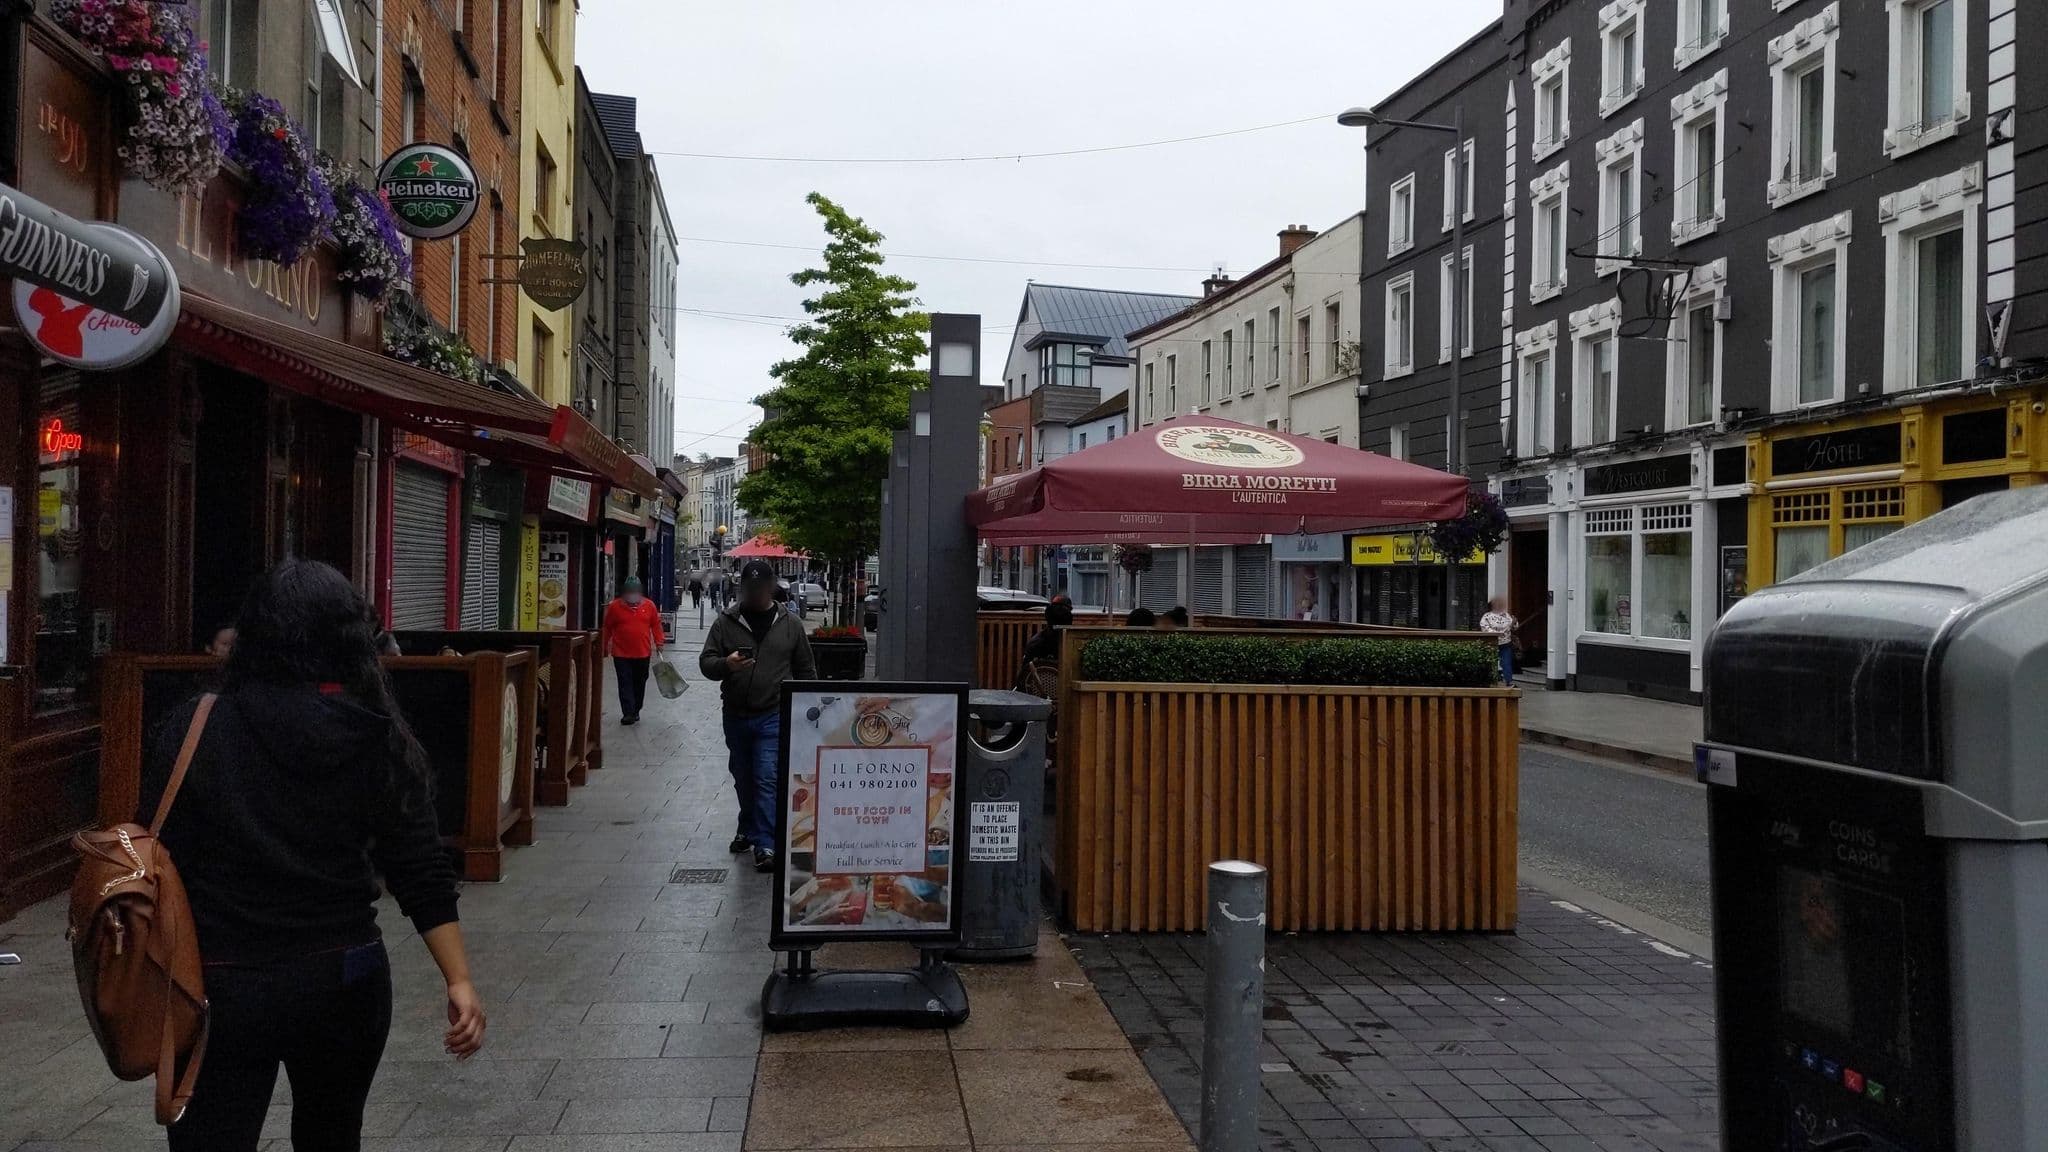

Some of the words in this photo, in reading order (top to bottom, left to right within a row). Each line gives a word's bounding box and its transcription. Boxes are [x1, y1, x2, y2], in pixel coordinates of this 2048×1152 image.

[385, 181, 471, 198] Heineken
[0, 195, 111, 297] GUINNESS
[47, 419, 82, 463] Open
[1161, 428, 1198, 449] BIRRA
[1199, 427, 1296, 453] MORETTI
[1182, 474, 1242, 489] BIRRA
[1245, 475, 1337, 492] MORETTI
[1232, 492, 1288, 504] L'AUTENTICA
[833, 763, 846, 775] IL
[856, 763, 916, 775] FORNO
[830, 780, 853, 790] 041
[859, 780, 917, 790] 9802100
[833, 806, 860, 816] BEST
[863, 806, 896, 816] FOOD
[899, 806, 912, 815] IN
[972, 804, 978, 813] IT
[979, 804, 985, 813] IS
[987, 804, 995, 813] AN
[996, 804, 1018, 813] OFFENCE
[855, 815, 890, 825] TOWN
[983, 815, 990, 823] TO
[991, 815, 1008, 823] PLACE
[972, 825, 999, 834] DOMESTIC
[1000, 825, 1017, 834] WASTE
[1828, 819, 1877, 848] COINS
[979, 836, 985, 844] IN
[987, 836, 999, 844] THIS
[1000, 836, 1010, 844] BIN
[836, 855, 853, 867] Full
[873, 856, 904, 867] Service
